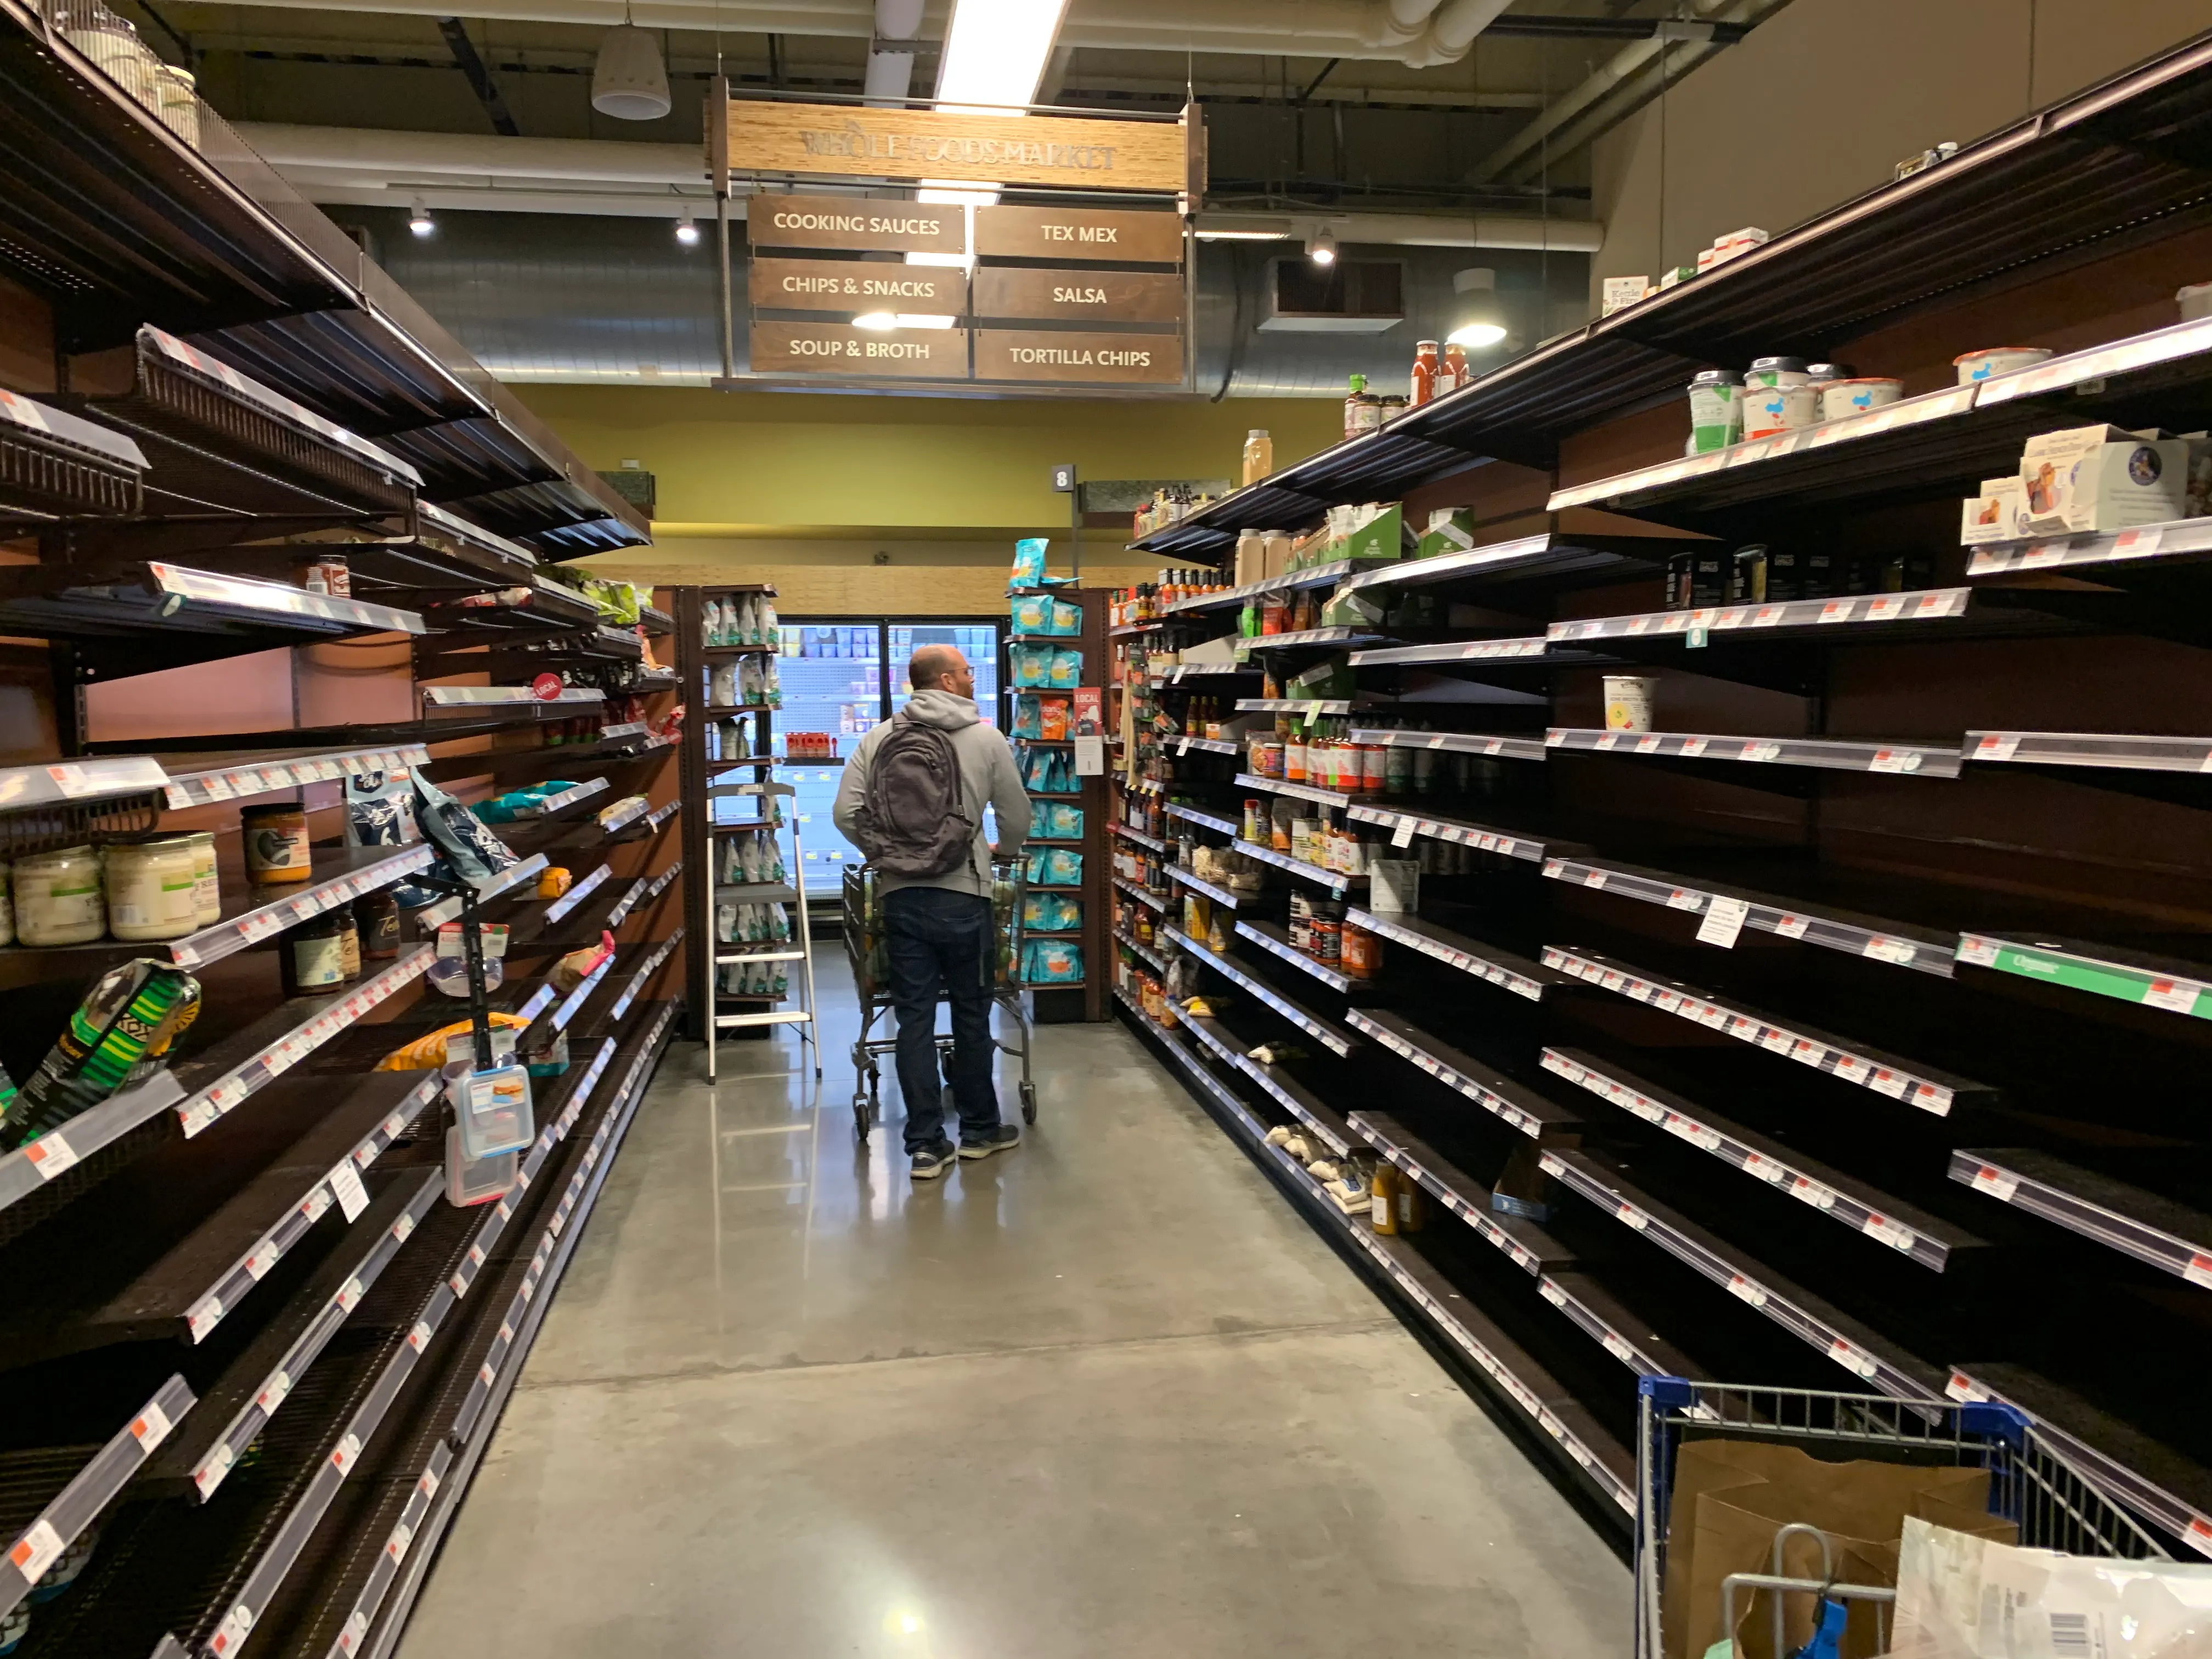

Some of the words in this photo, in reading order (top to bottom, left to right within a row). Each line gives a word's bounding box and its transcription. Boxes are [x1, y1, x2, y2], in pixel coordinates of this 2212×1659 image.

[798, 129, 902, 159] WHOLE
[906, 136, 1000, 163] FOODS
[1003, 140, 1118, 170] MARKET
[774, 212, 865, 232] COOKING
[869, 217, 940, 235] SAUCES
[1041, 225, 1074, 241] TEX
[1079, 227, 1118, 243] MEX
[782, 276, 839, 293] CHIPS
[843, 278, 859, 295] &
[862, 280, 935, 297] SNACKS
[1053, 287, 1108, 303] SALSA
[789, 339, 843, 356] SOUP
[846, 340, 862, 357] &
[865, 342, 930, 359] BROTH
[1009, 348, 1094, 365] TORTILLA
[1097, 351, 1151, 367] CHIPS
[1056, 471, 1068, 487] 8
[1075, 693, 1099, 703] LOCAL
